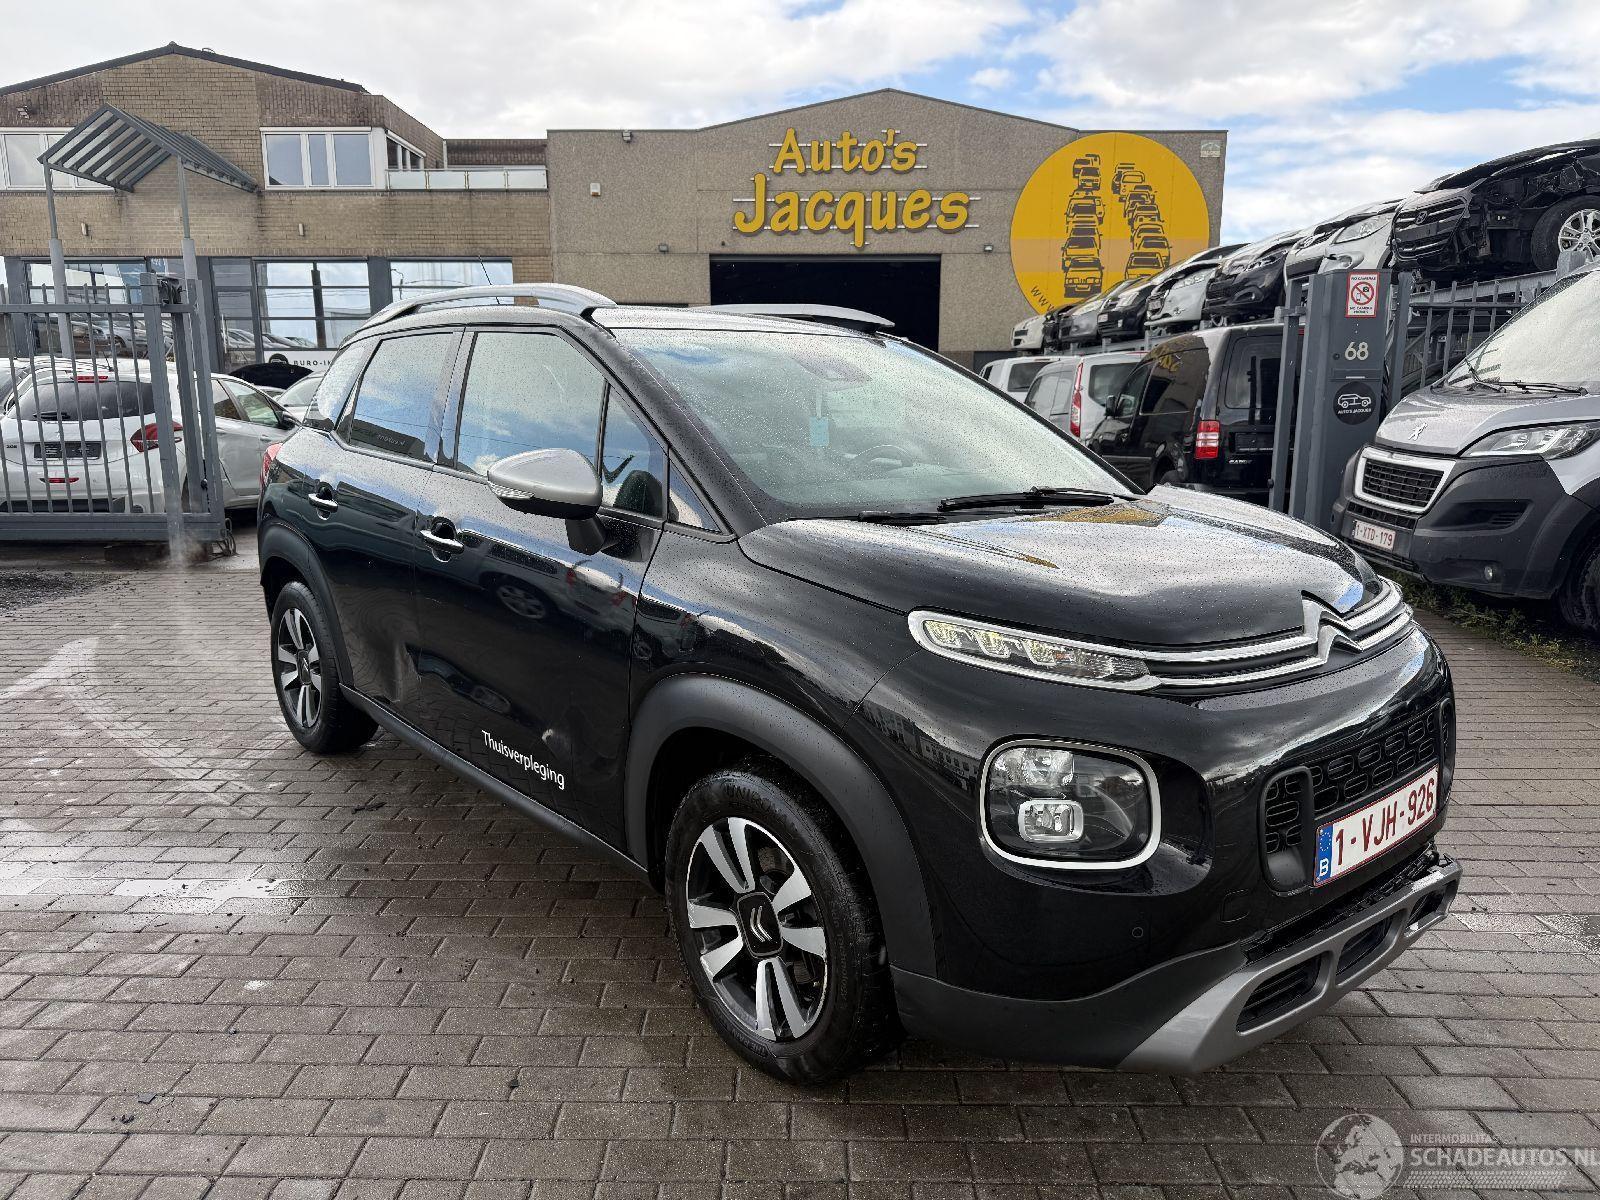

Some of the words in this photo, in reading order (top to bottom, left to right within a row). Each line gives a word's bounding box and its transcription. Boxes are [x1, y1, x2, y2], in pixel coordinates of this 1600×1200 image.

[773, 127, 918, 174] Auto's
[733, 173, 970, 247] Jacques
[1344, 341, 1369, 361] 68
[481, 729, 565, 790] Thuisverpleging
[1335, 777, 1436, 866] 1-VJH-926
[1319, 857, 1330, 877] B
